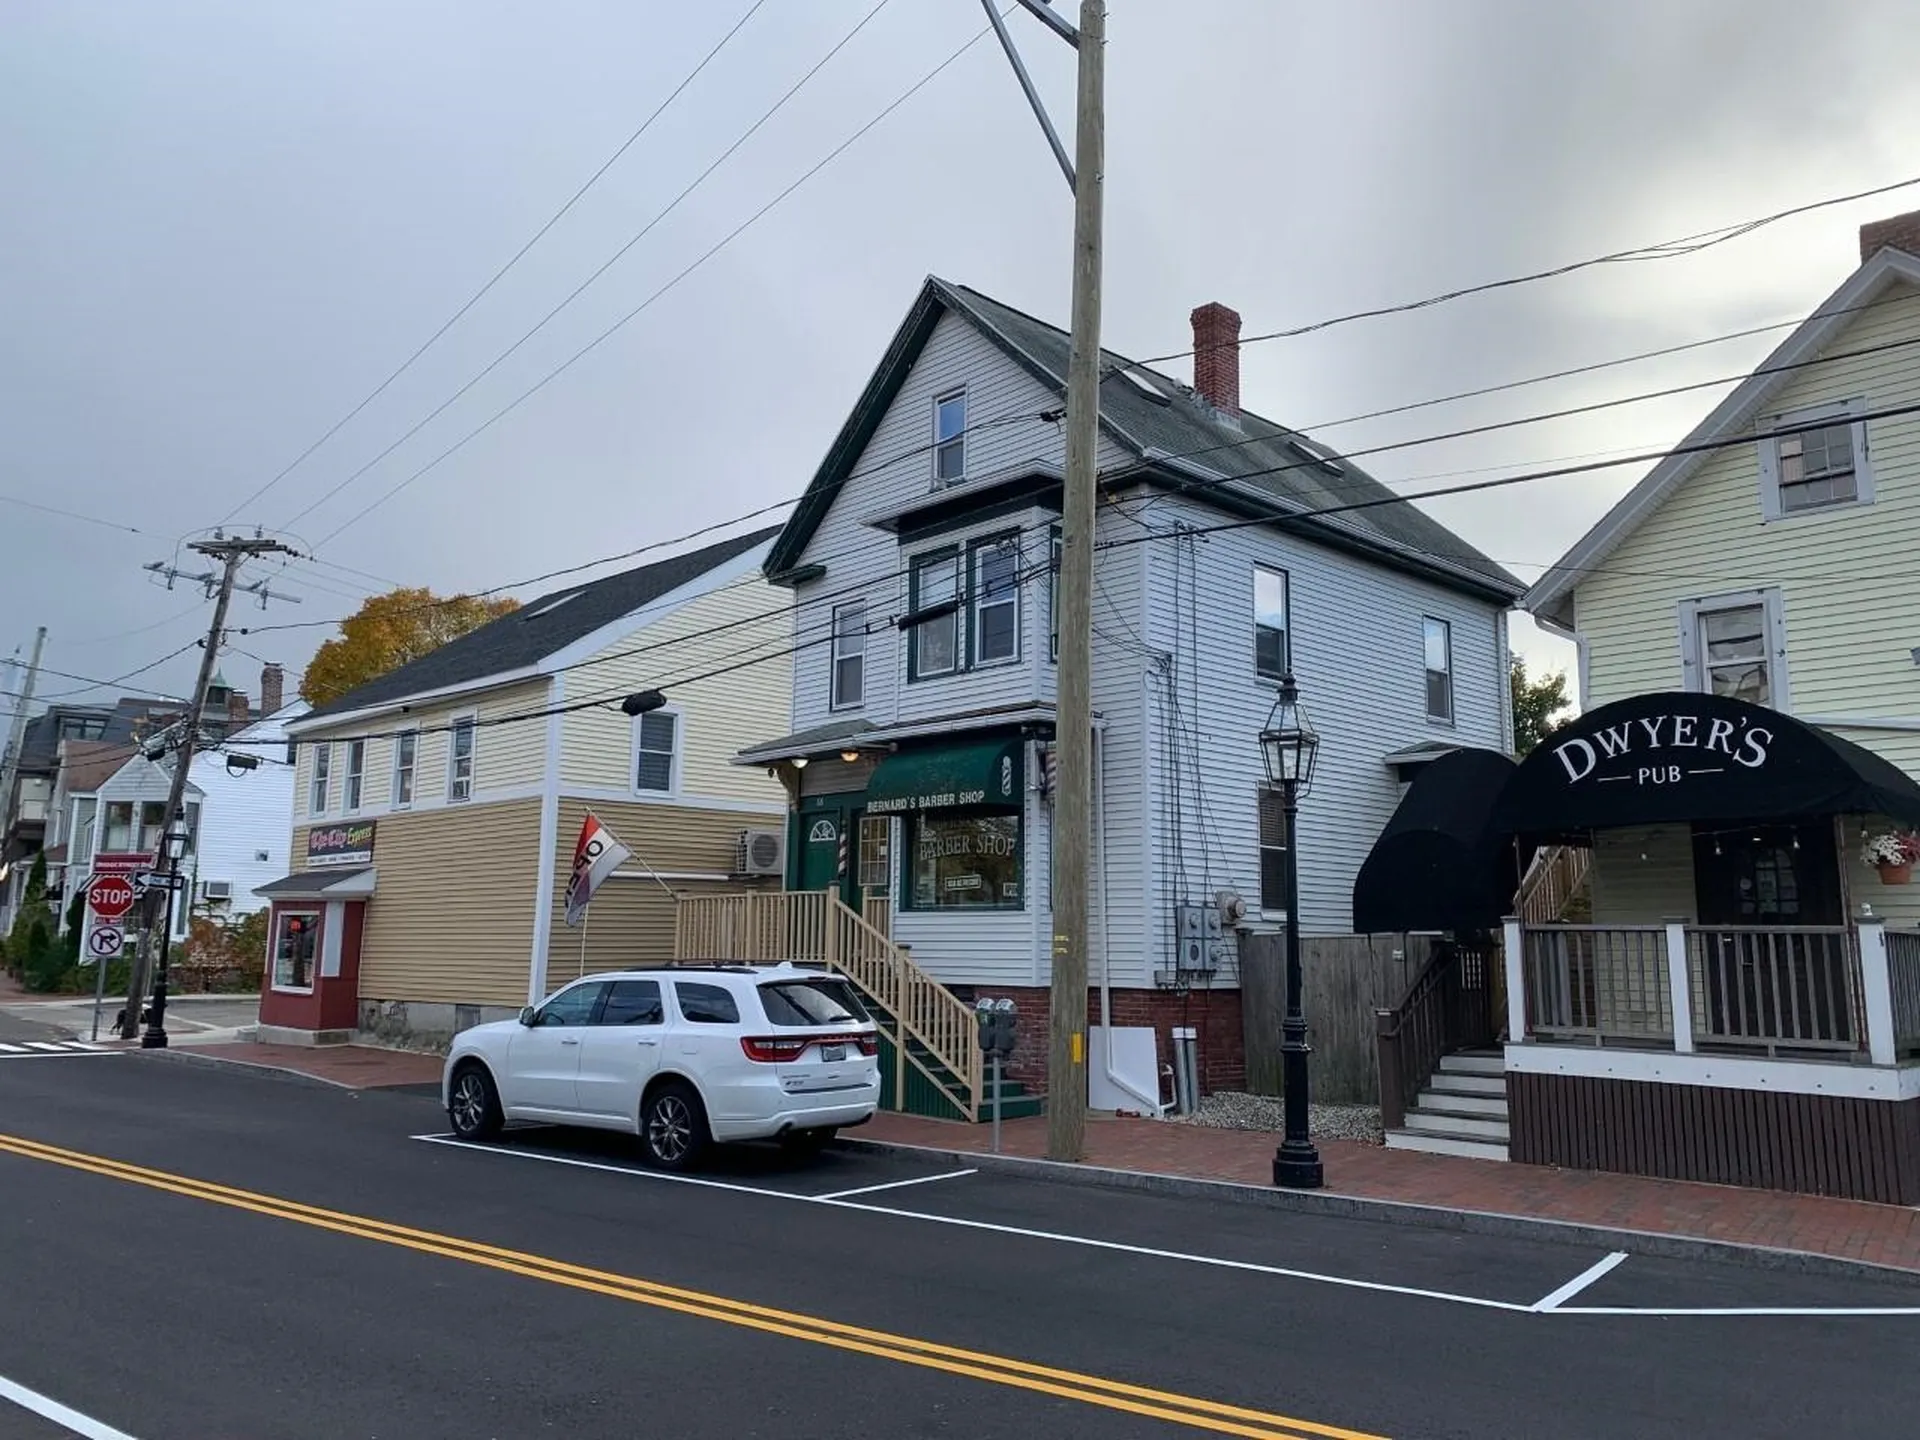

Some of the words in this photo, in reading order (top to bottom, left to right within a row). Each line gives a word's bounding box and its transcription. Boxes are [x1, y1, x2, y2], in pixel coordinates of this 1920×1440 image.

[1552, 715, 1774, 784] DWYER'S
[1638, 766, 1681, 785] PUB
[867, 796, 916, 813] BERNARD'S
[919, 793, 955, 808] BARBER
[959, 790, 985, 804] SHOP
[920, 835, 970, 860] BARBER
[976, 833, 1015, 856] SHOP
[91, 889, 131, 904] STOP
